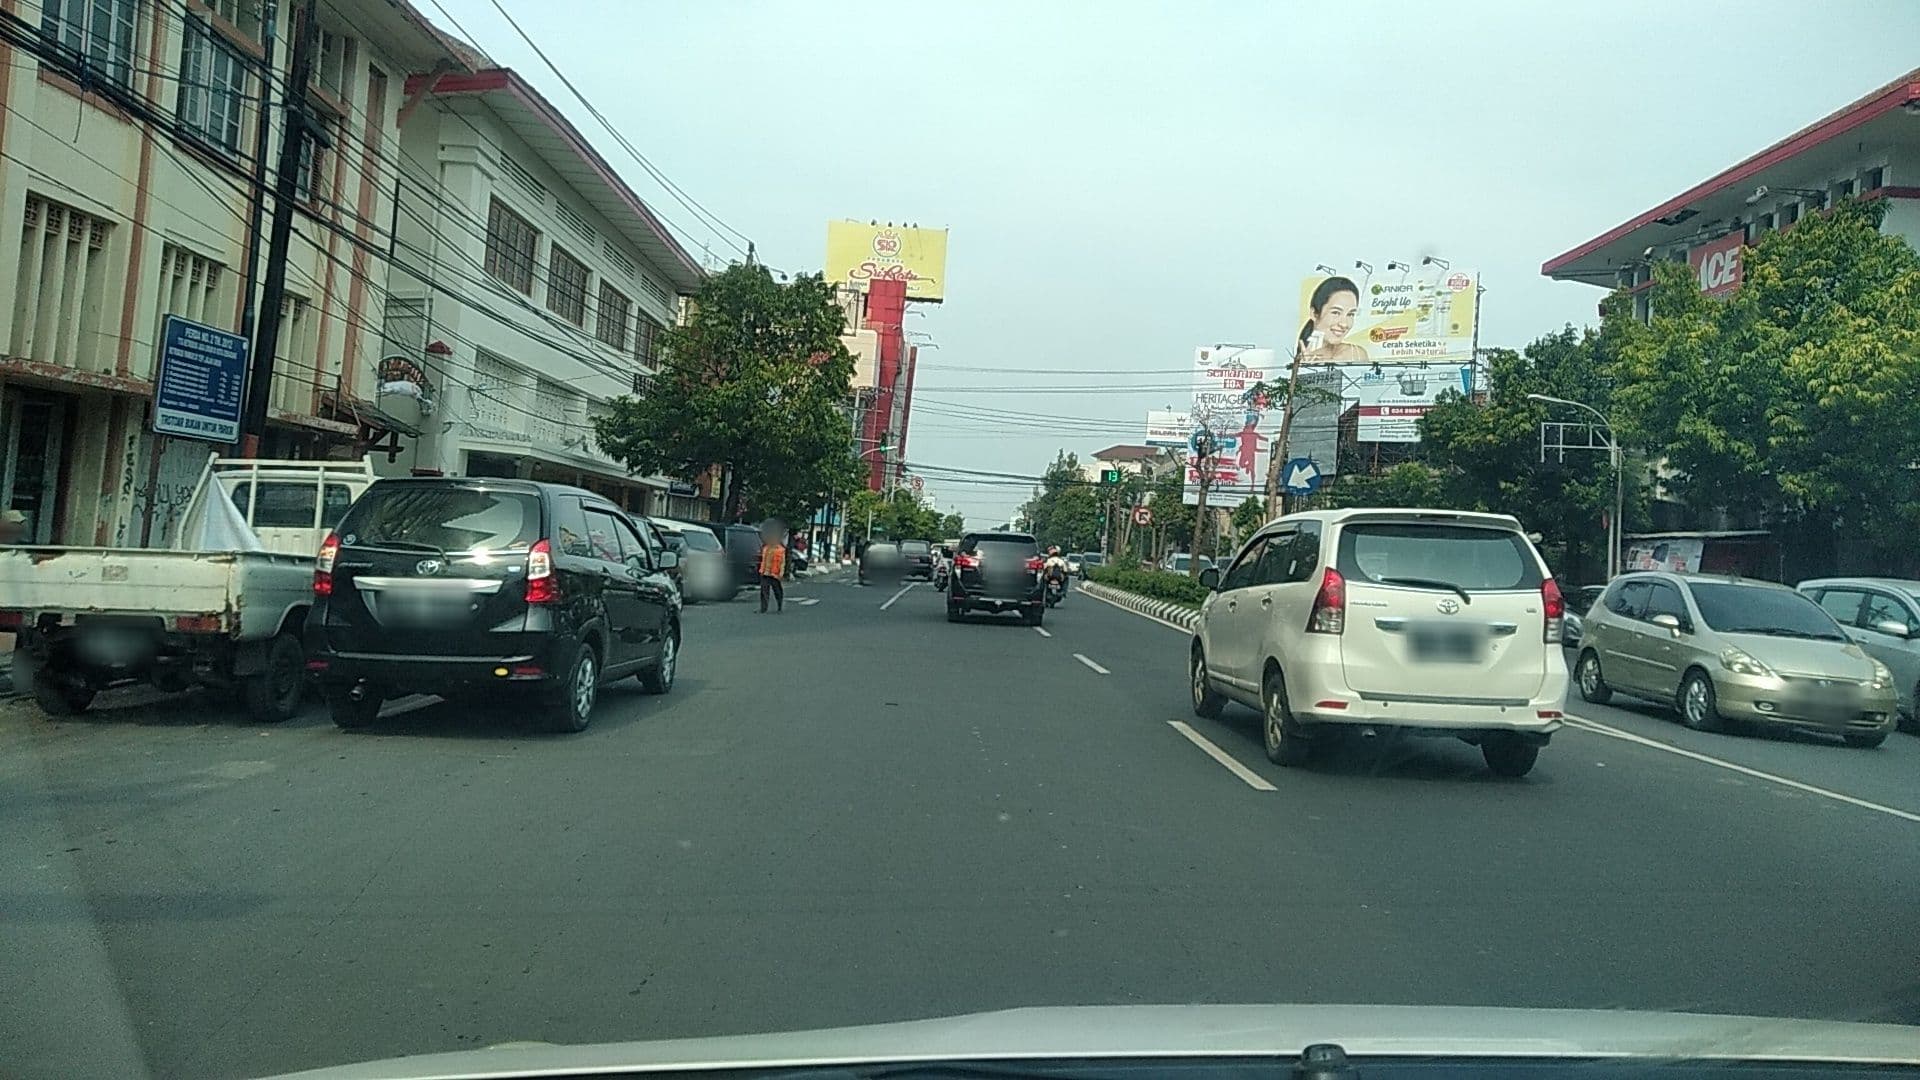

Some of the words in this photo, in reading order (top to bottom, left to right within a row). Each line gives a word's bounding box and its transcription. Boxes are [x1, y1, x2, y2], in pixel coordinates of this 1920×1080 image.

[1371, 284, 1414, 296] GARNIER
[1372, 297, 1399, 311] Bright
[1399, 296, 1412, 308] Up
[1382, 341, 1404, 349] Cerah
[1405, 340, 1437, 349] Seketika
[1391, 348, 1414, 356] Lebih
[1414, 347, 1447, 356] Natural
[1108, 471, 1118, 482] 13
